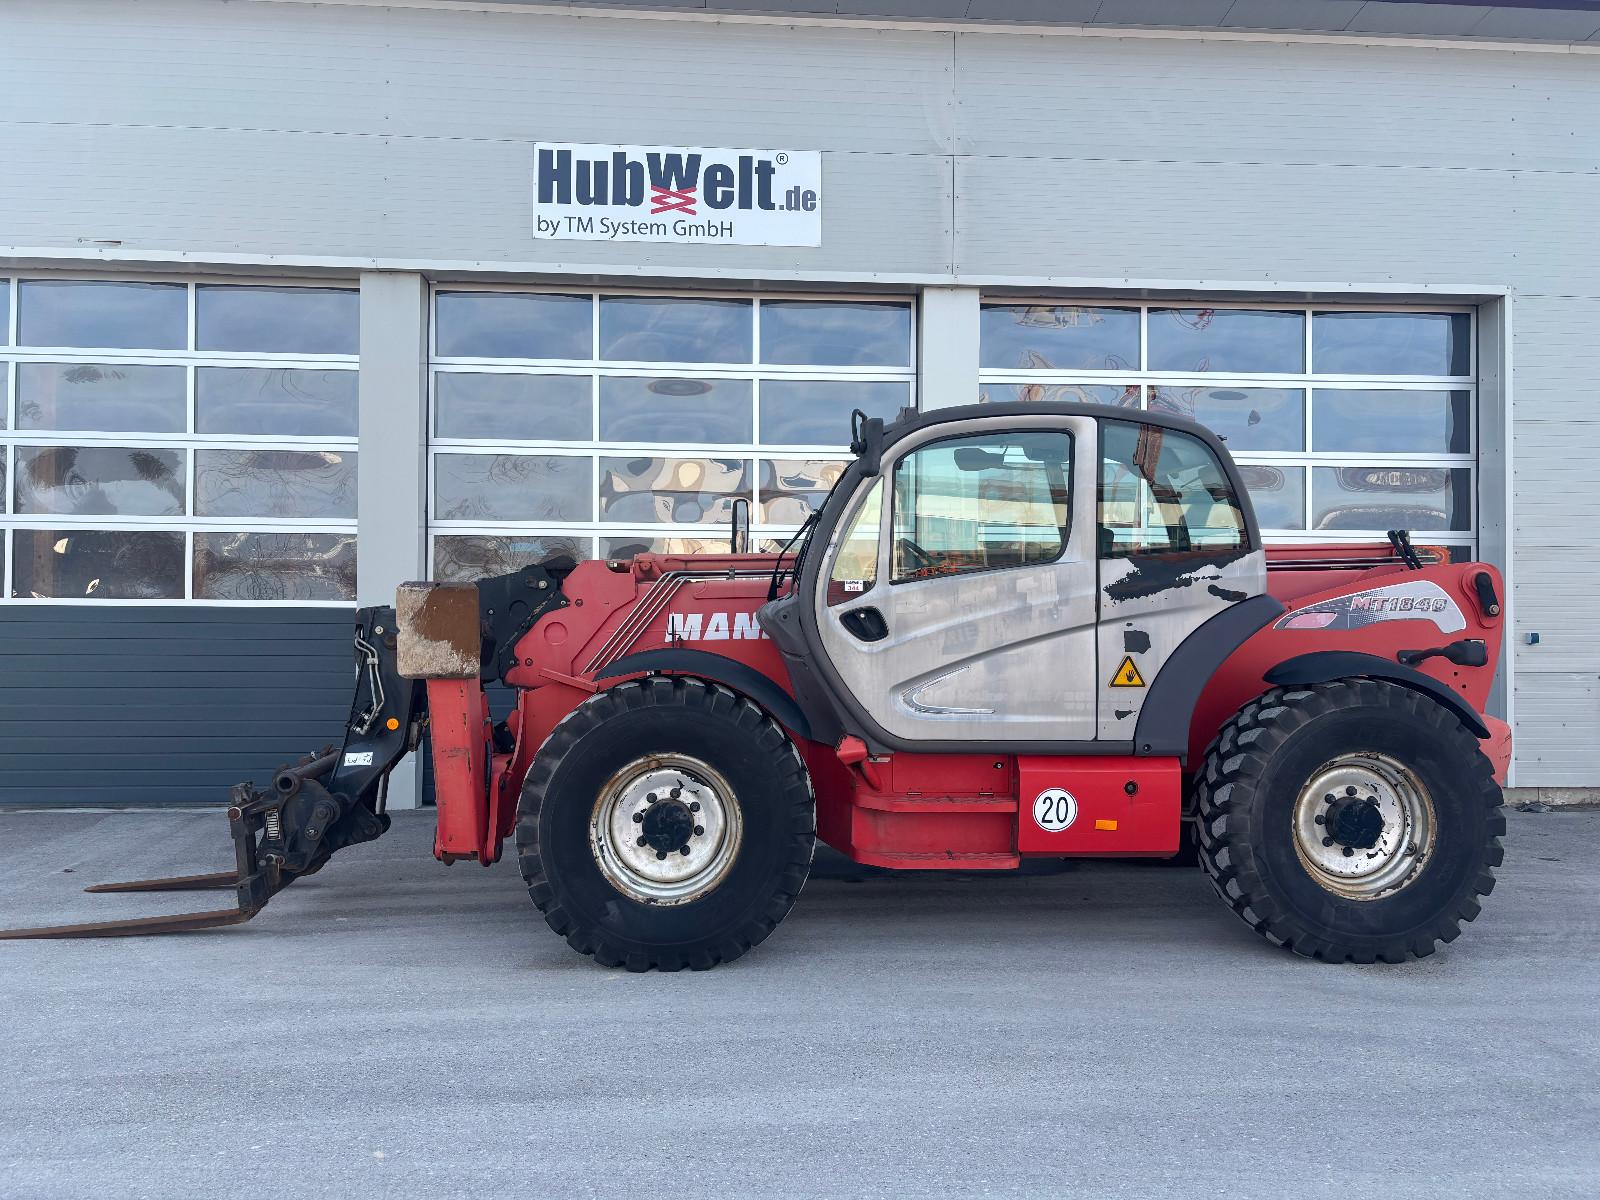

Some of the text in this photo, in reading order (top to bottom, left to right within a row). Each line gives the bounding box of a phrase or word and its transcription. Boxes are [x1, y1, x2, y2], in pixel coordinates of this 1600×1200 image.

[537, 215, 733, 239] by TM System GmbH
[1351, 597, 1447, 612] MT1840
[664, 612, 771, 642] MAN
[1041, 796, 1069, 823] 20
